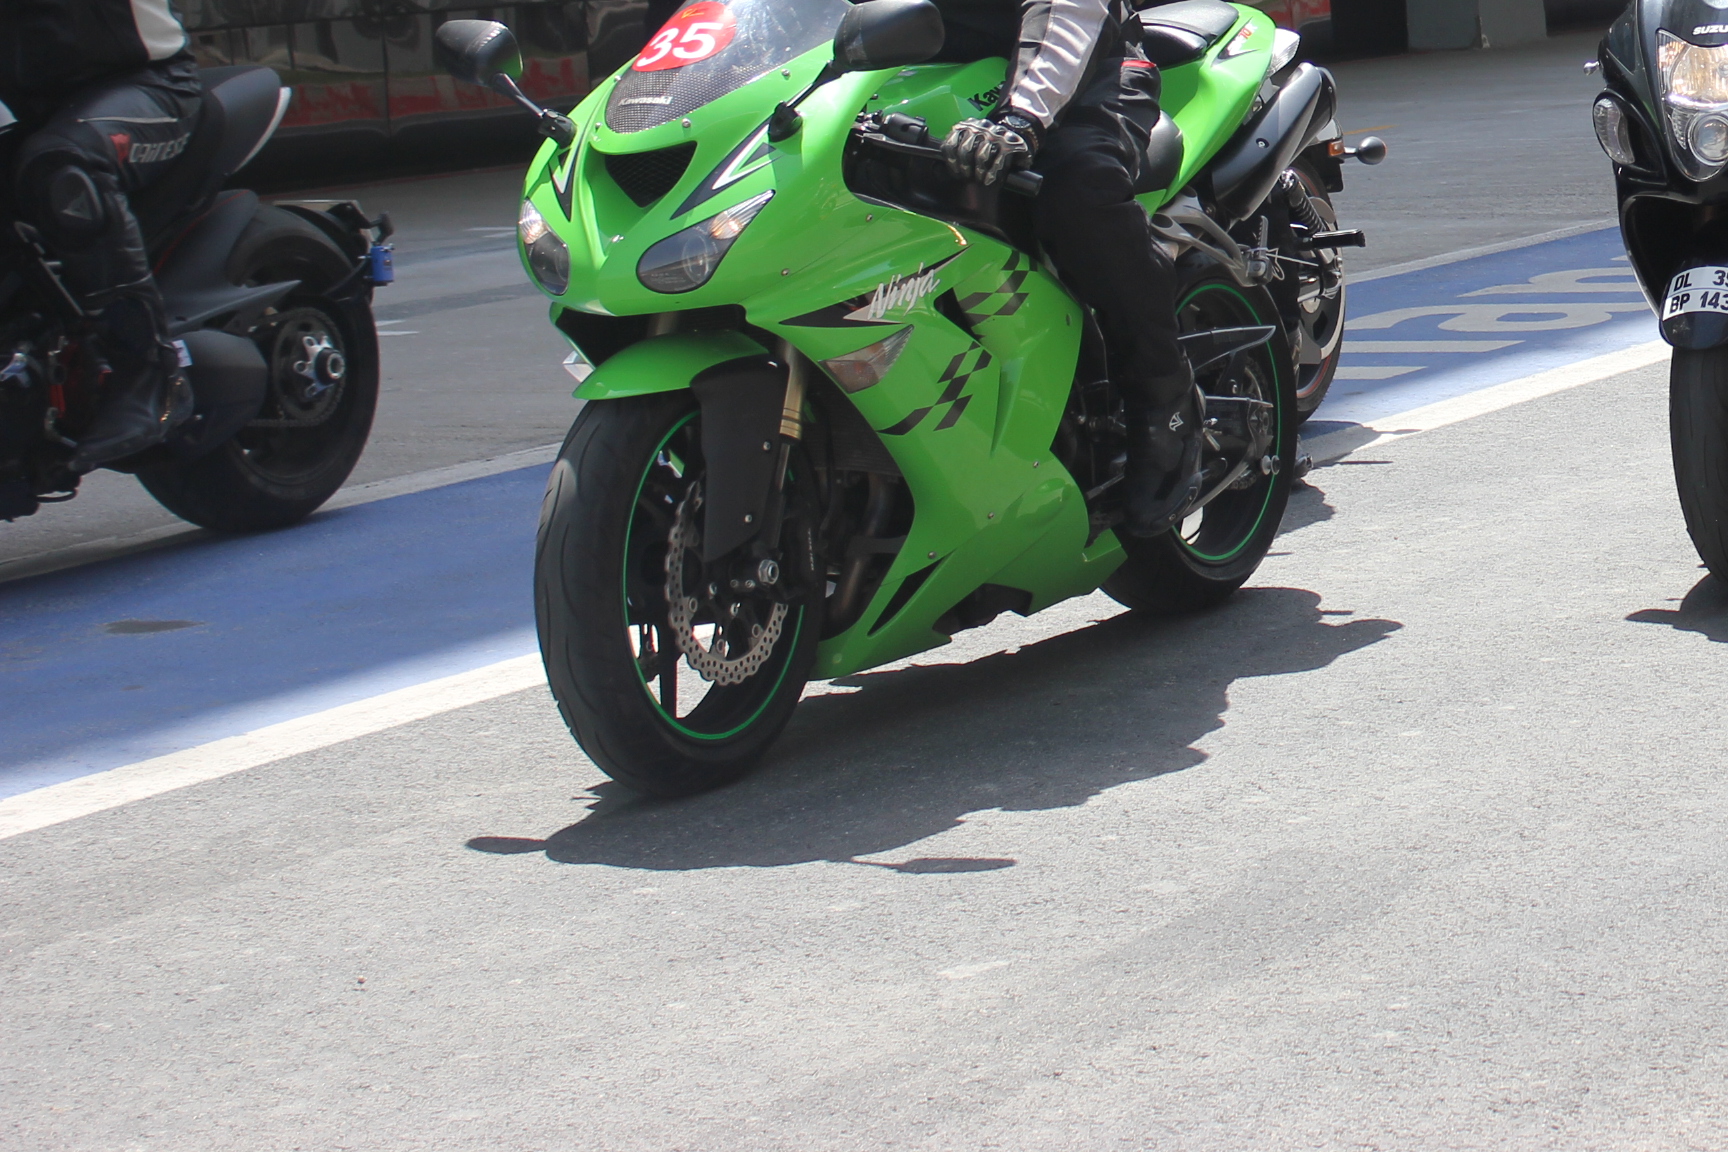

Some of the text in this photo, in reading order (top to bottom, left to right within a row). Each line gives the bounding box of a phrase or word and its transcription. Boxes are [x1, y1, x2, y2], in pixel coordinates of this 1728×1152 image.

[636, 22, 724, 67] 35
[618, 95, 673, 106] Kawasaki
[867, 261, 941, 320] Ninja
[1673, 272, 1693, 293] DL
[1669, 292, 1691, 315] BP
